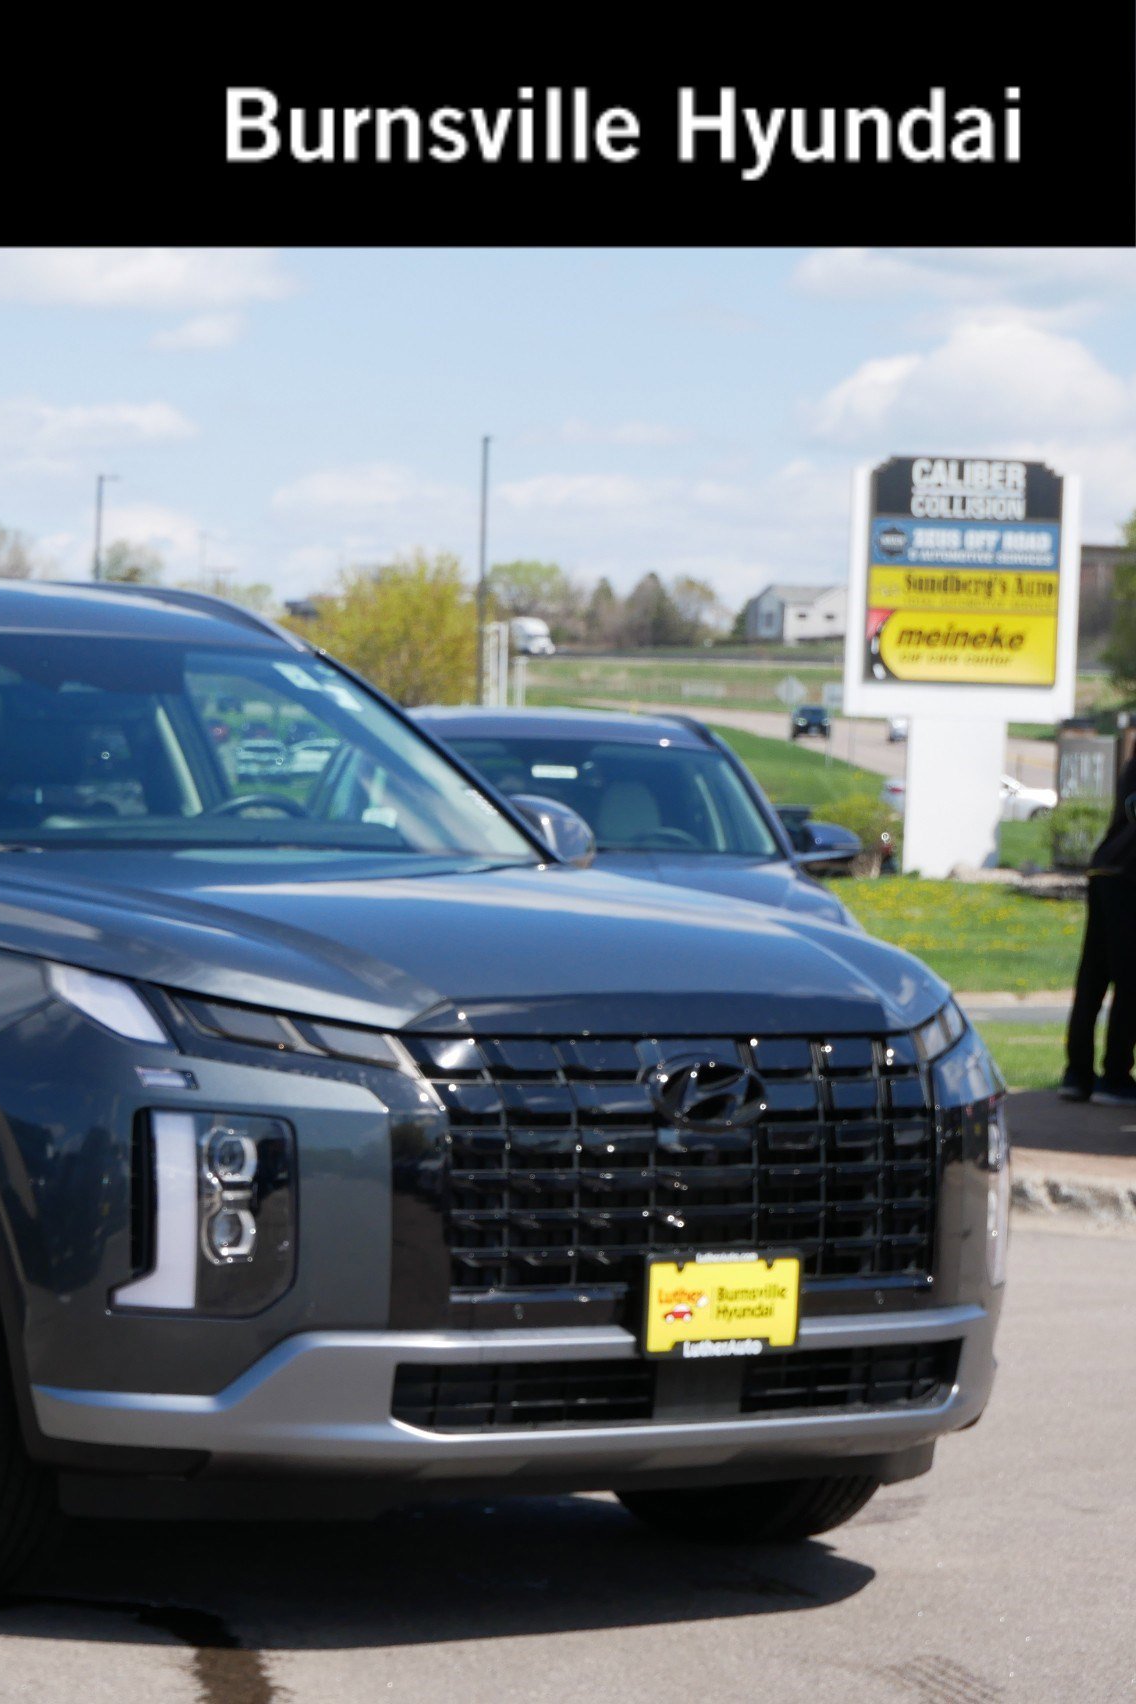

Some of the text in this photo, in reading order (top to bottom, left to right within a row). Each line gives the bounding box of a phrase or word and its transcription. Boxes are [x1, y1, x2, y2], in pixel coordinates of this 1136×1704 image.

[911, 457, 1027, 490] CALIBER
[910, 495, 1026, 521] COLLISION
[896, 623, 1026, 652] meineke
[658, 1287, 703, 1304] Luther
[716, 1285, 787, 1301] Burnsville
[716, 1304, 774, 1322] Hyundai
